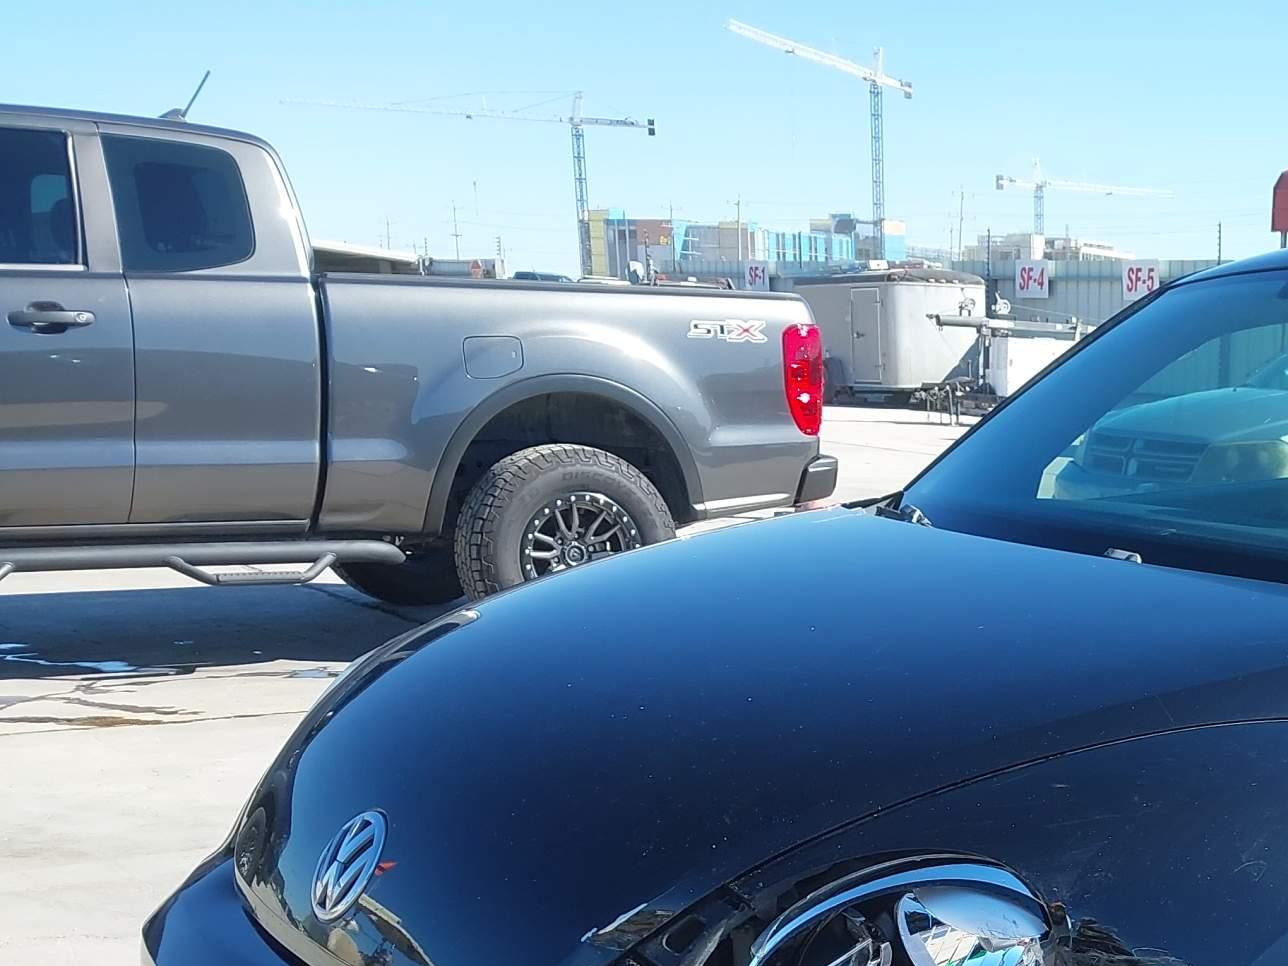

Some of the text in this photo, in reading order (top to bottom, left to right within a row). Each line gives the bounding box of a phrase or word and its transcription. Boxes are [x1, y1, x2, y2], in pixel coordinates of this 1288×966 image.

[749, 266, 766, 286] SF-1
[1019, 266, 1045, 291] SF-4
[1126, 267, 1156, 293] SF-5
[687, 320, 768, 343] STX
